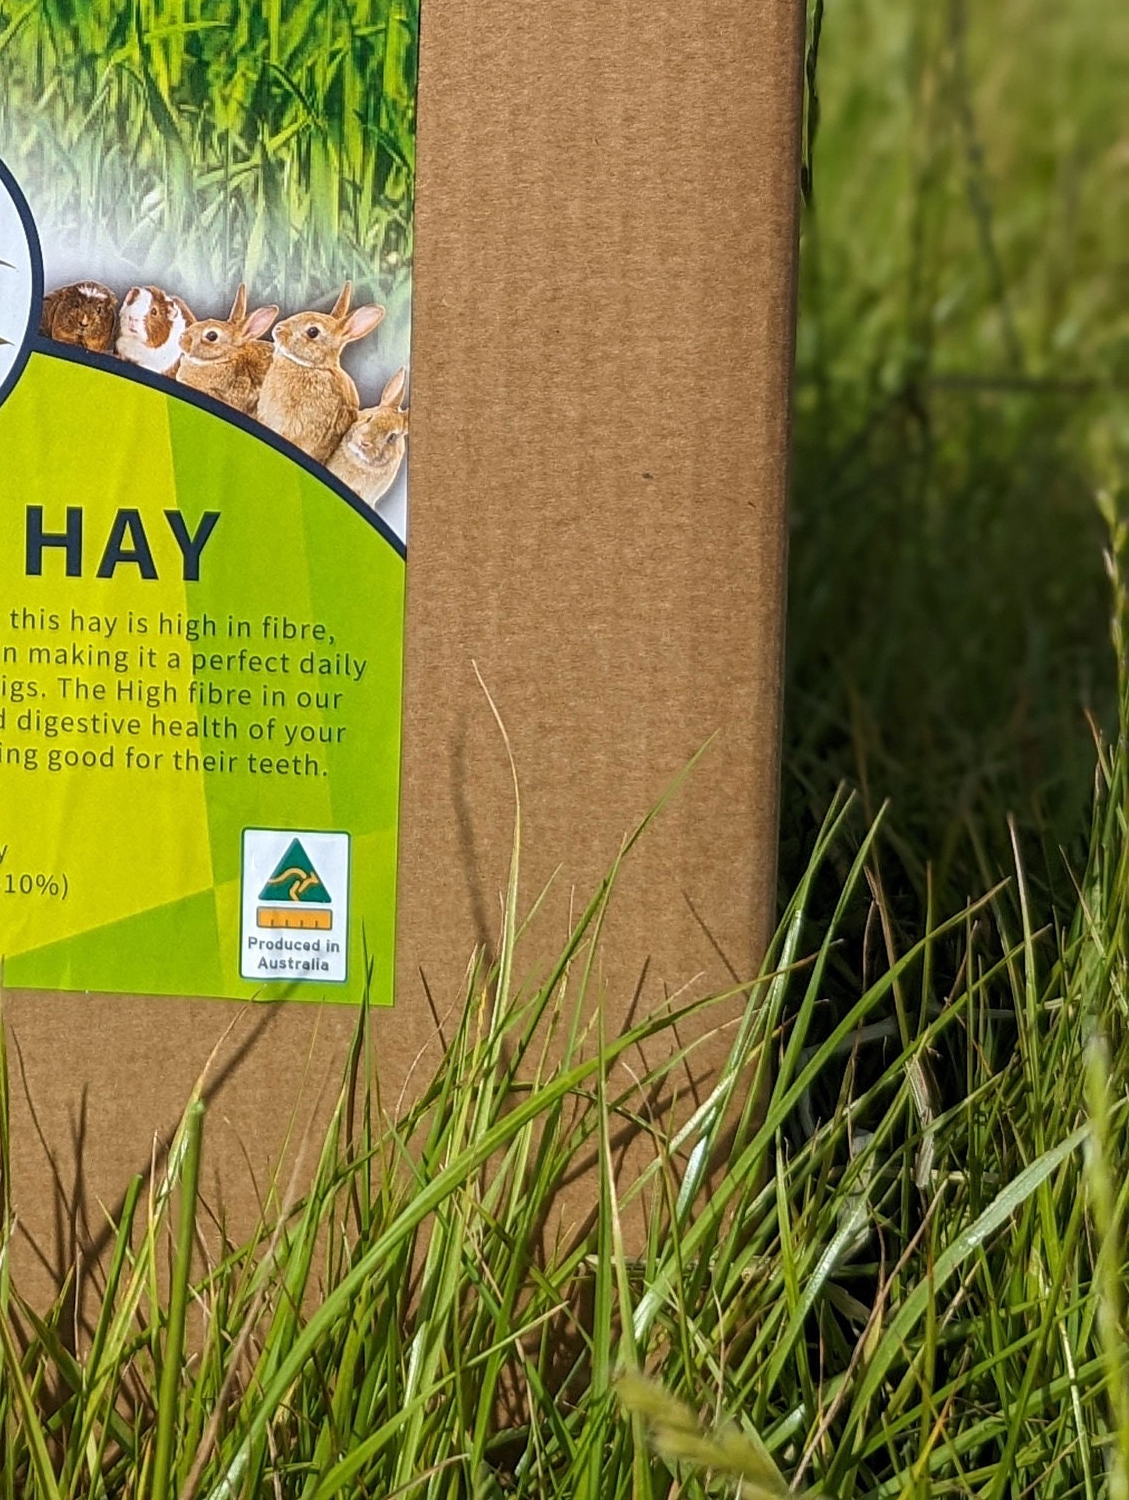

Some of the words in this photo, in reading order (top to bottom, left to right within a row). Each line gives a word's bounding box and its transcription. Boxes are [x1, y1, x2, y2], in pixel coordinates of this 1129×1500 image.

[26, 505, 221, 581] HAY
[10, 608, 60, 631] this
[71, 610, 117, 638] hay
[128, 612, 148, 633] is
[160, 613, 216, 641] high
[228, 615, 251, 638] in
[262, 616, 336, 644] fibre,
[29, 644, 129, 672] making
[139, 646, 157, 669] it
[167, 652, 181, 670] a
[192, 649, 290, 675] perfect
[300, 652, 367, 680] daily
[57, 677, 107, 700] The
[117, 680, 178, 707] High
[188, 681, 251, 706] fibre
[262, 685, 285, 707] in
[297, 690, 343, 709] our
[17, 710, 141, 737] digestive
[152, 714, 238, 739] health
[249, 718, 275, 740] of
[285, 725, 346, 746] your
[48, 746, 113, 771] good
[126, 747, 163, 770] for
[174, 749, 238, 773] their
[248, 752, 328, 777] teeth.
[248, 936, 320, 952] Produced
[326, 940, 340, 952] in
[257, 956, 329, 971] Australia
